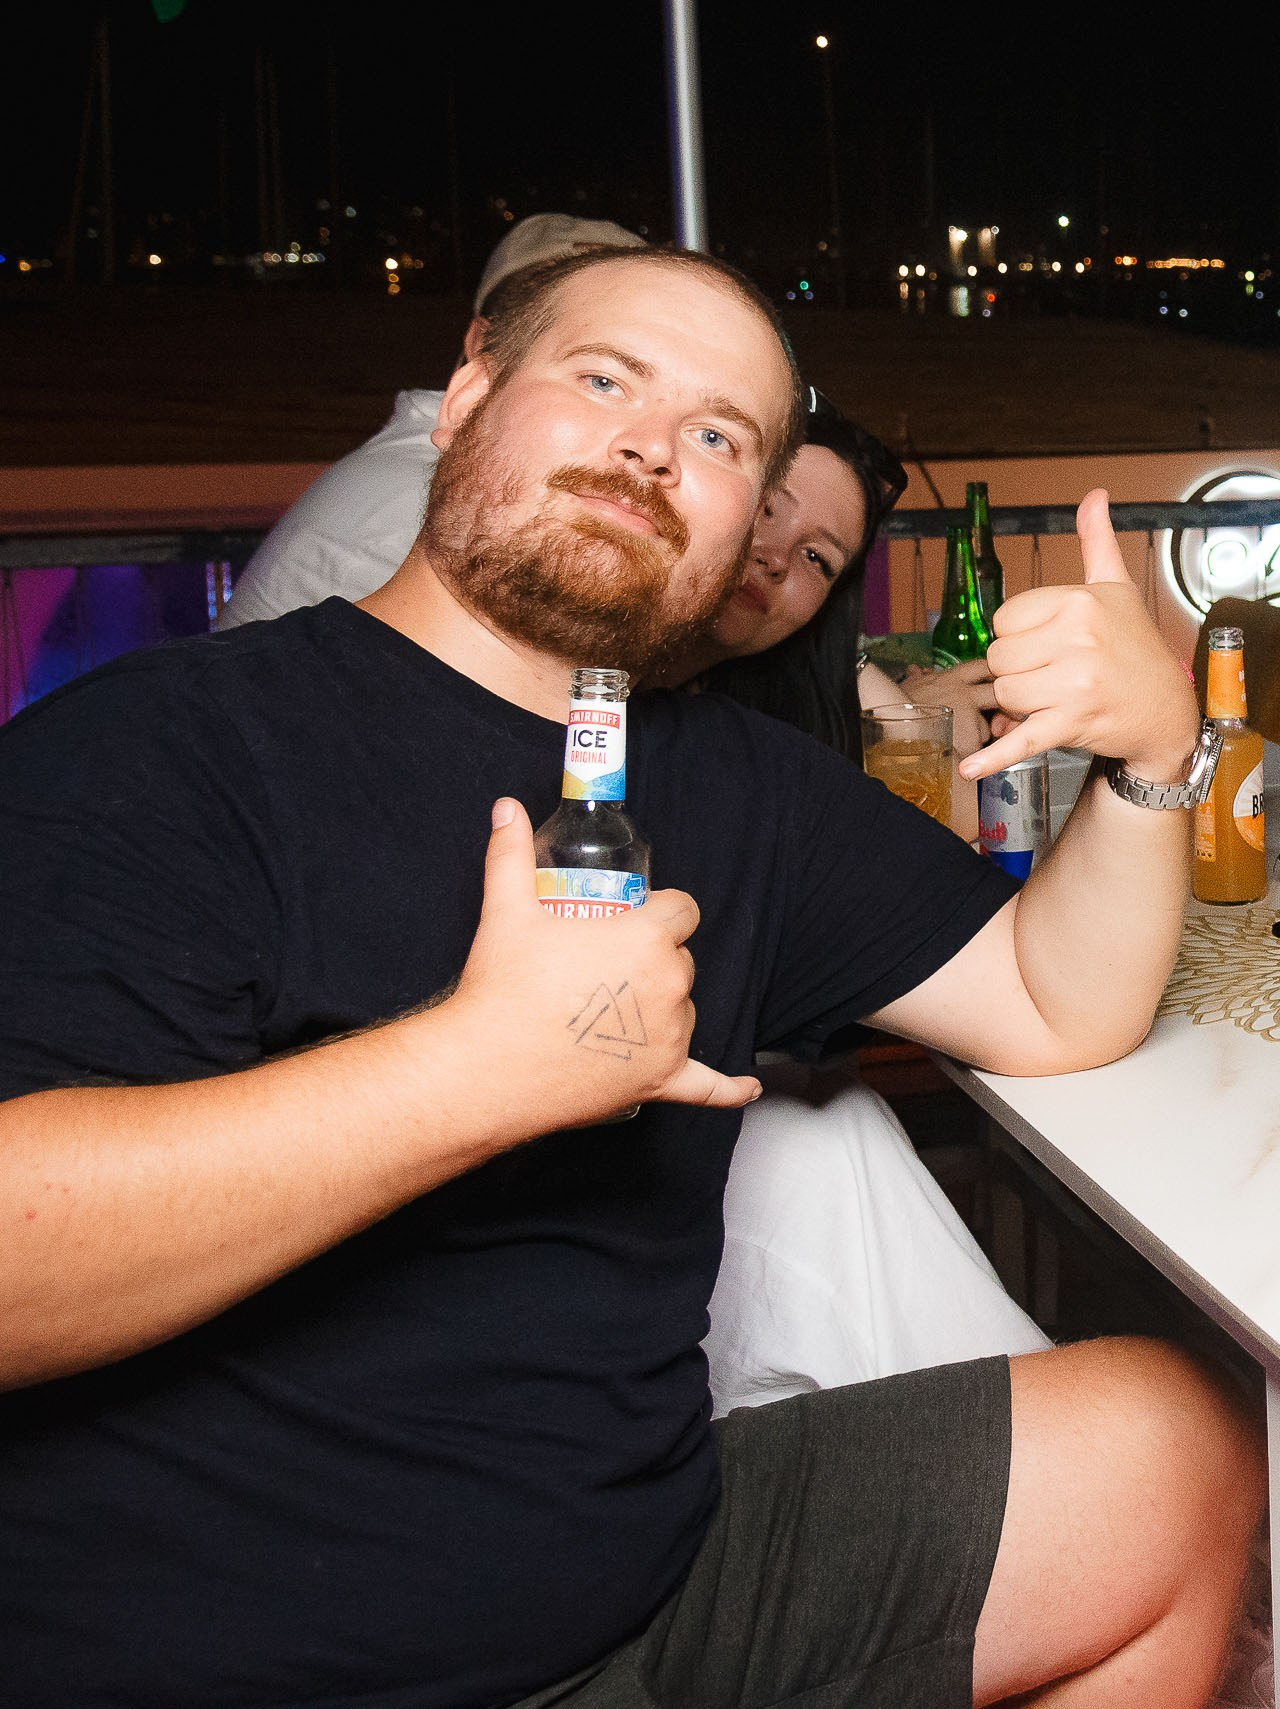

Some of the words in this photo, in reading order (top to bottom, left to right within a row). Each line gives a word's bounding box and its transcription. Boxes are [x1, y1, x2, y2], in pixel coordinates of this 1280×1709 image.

[570, 711, 618, 726] SMIRNOFF
[573, 729, 608, 748] ICE
[570, 750, 607, 764] ORIGINAL
